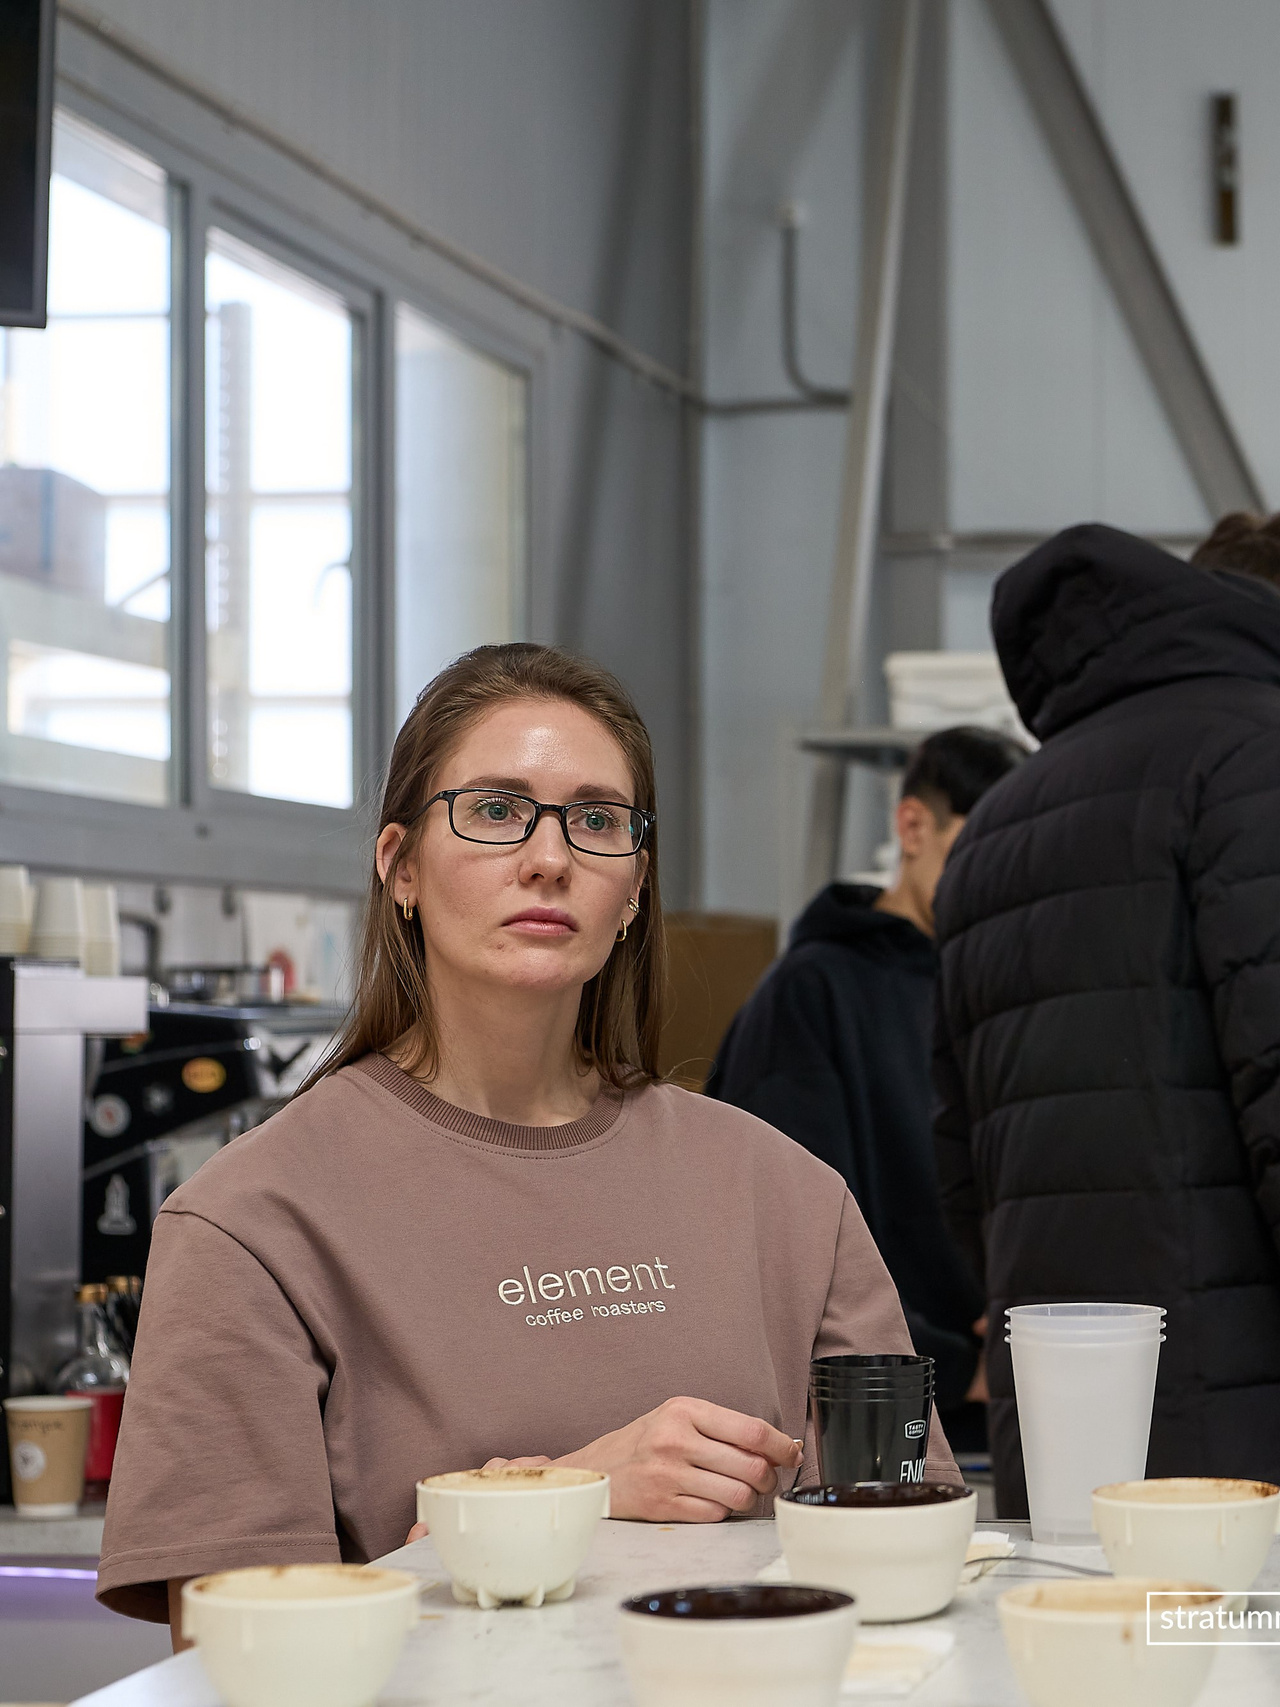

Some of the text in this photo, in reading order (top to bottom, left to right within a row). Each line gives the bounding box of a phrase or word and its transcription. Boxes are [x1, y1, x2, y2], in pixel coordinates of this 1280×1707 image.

[498, 1256, 676, 1305] element
[525, 1300, 666, 1326] coffee roasters
